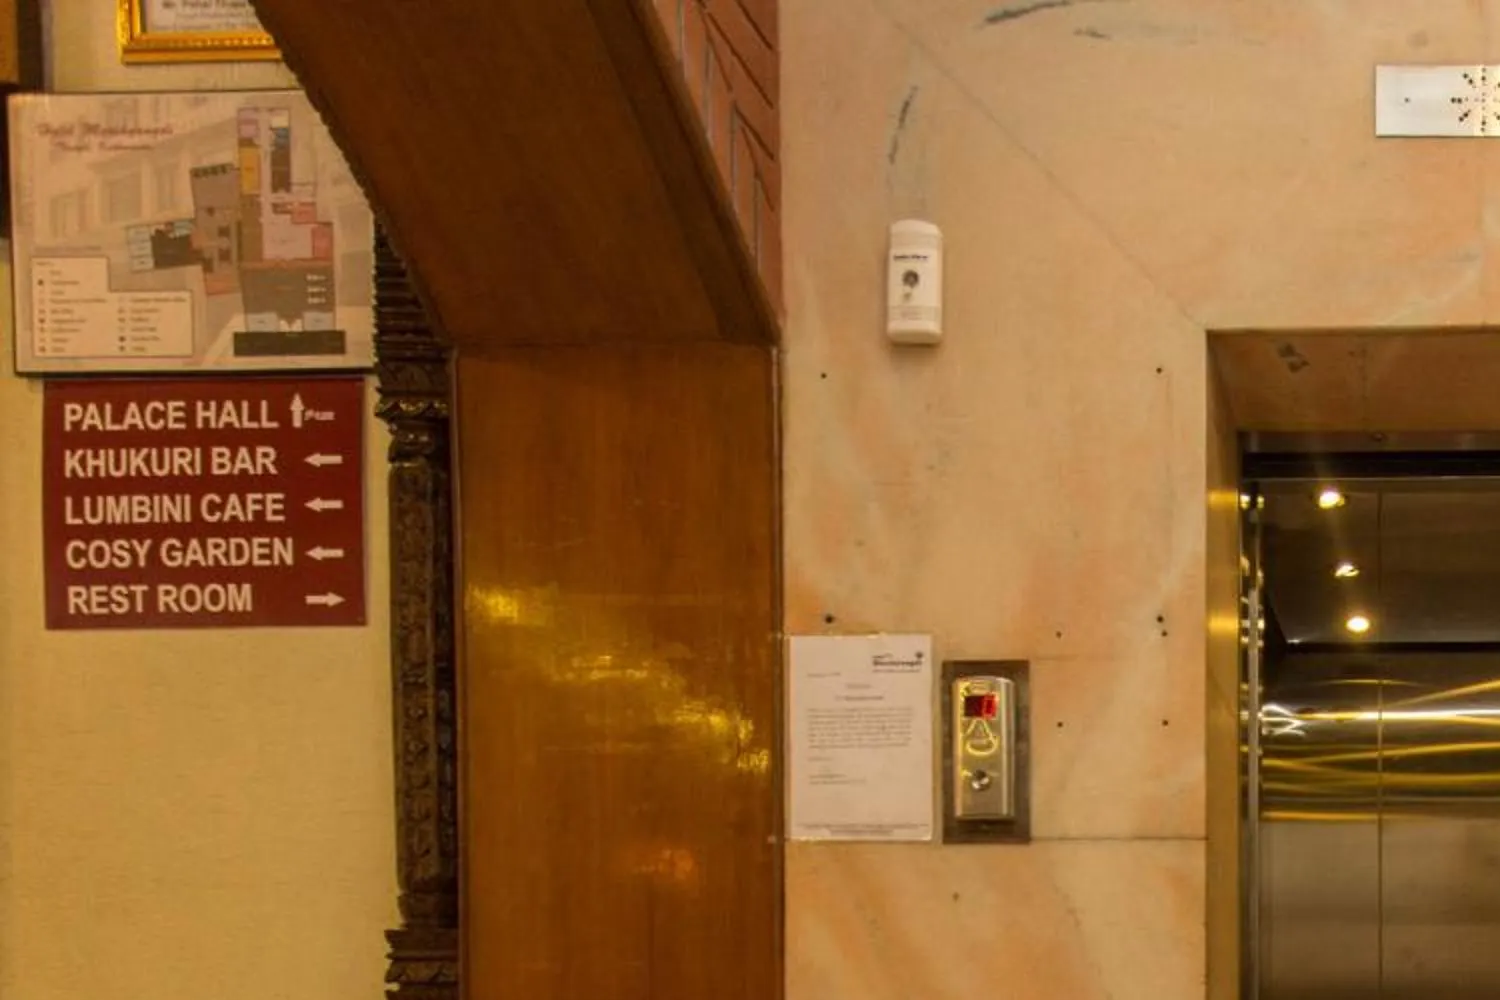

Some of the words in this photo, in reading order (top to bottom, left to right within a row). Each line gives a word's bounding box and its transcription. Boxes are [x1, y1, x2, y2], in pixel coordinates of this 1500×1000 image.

[64, 401, 187, 431] PALACE
[196, 400, 279, 429] HALL
[64, 447, 201, 478] KHUKURI
[211, 446, 278, 475] BAR
[65, 494, 191, 524] LUMBINI
[200, 493, 285, 522] CAFE
[66, 539, 152, 569] COSY
[160, 537, 293, 567] GARDEN
[67, 585, 148, 615] REST
[157, 583, 253, 613] ROOM
